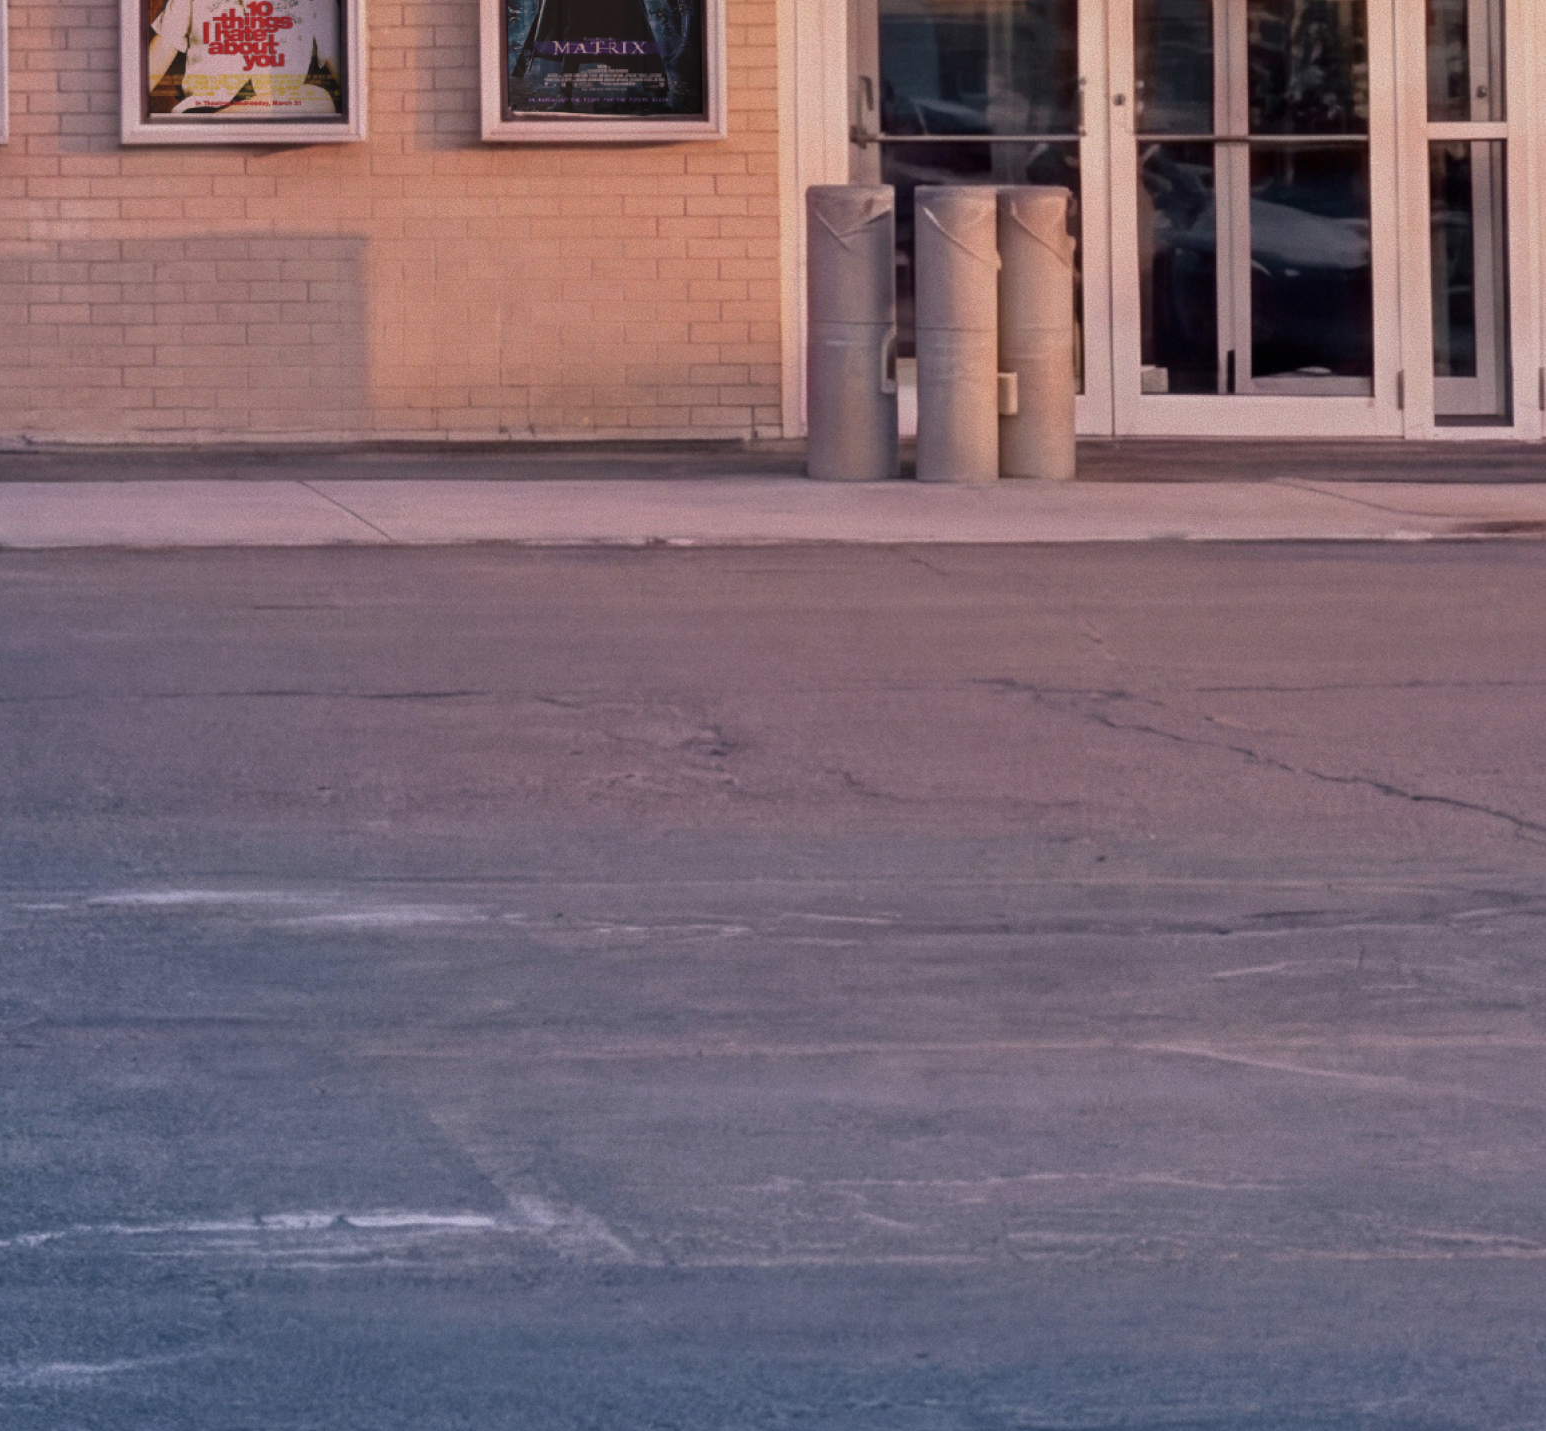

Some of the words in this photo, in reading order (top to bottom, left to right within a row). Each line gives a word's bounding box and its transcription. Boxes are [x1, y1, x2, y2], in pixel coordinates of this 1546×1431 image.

[246, 1, 274, 16] 10
[212, 8, 294, 33] things
[203, 21, 210, 44] I
[215, 22, 268, 42] hate
[208, 33, 280, 55] about
[551, 39, 647, 56] MATRIX
[242, 53, 286, 72] you
